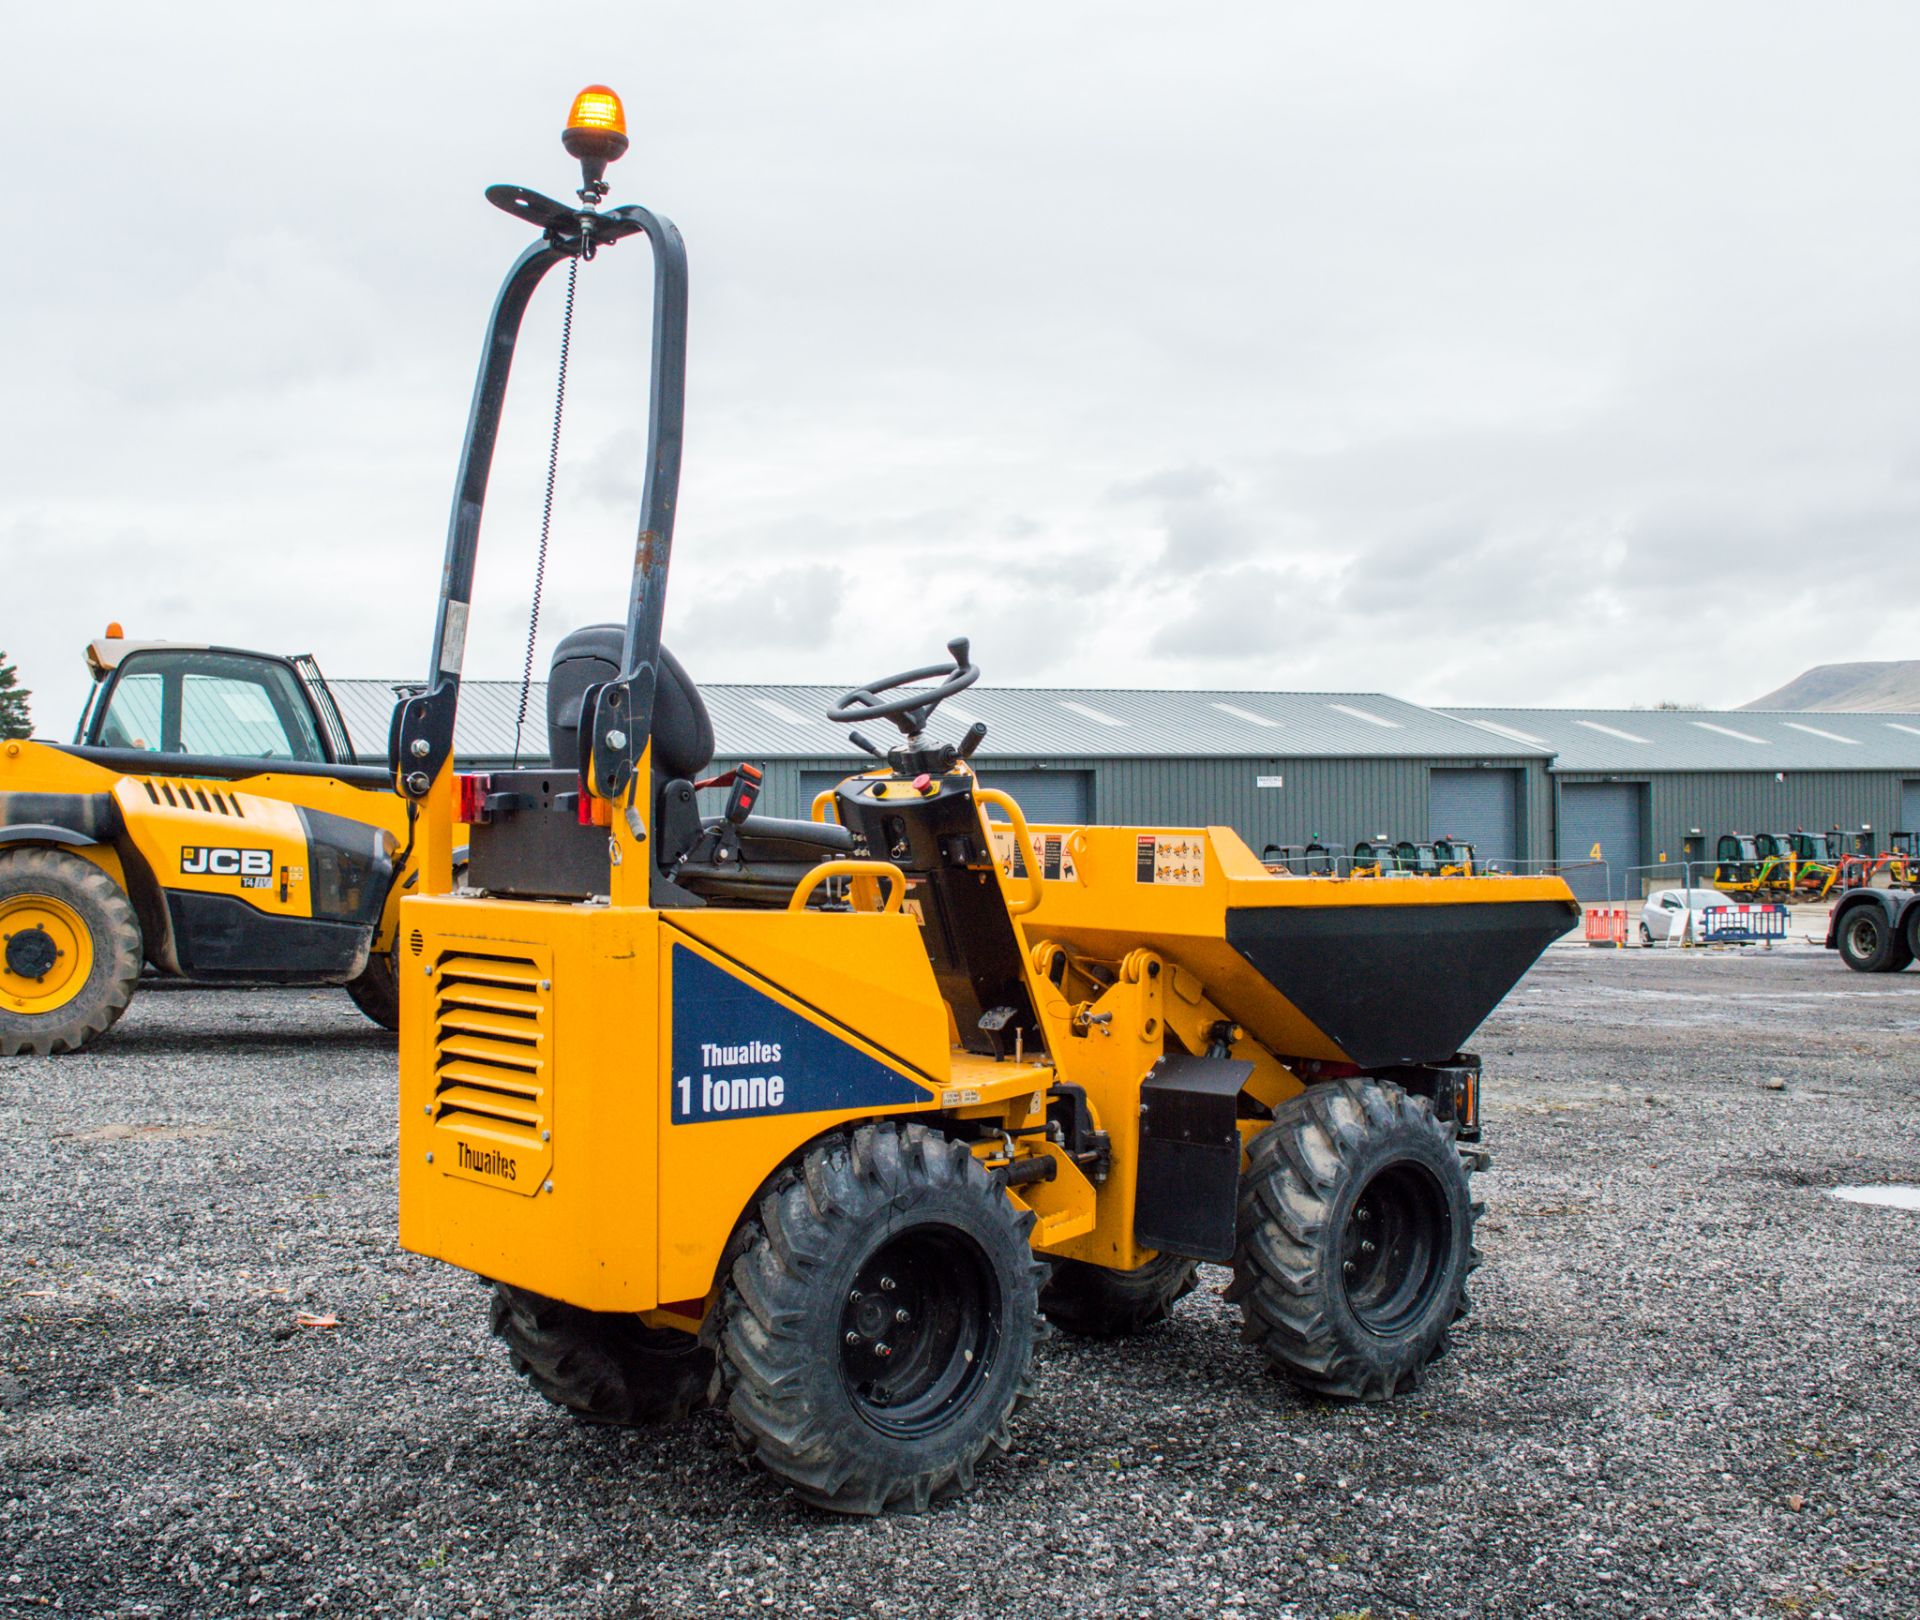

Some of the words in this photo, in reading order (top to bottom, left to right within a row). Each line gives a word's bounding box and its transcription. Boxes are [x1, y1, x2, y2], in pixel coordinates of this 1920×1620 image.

[182, 848, 272, 875] JCB
[1589, 842, 1601, 862] 4
[701, 1041, 782, 1067] Thwaites
[677, 1076, 691, 1115] 1
[702, 1073, 785, 1113] tonne
[457, 1141, 517, 1181] Thwaites
